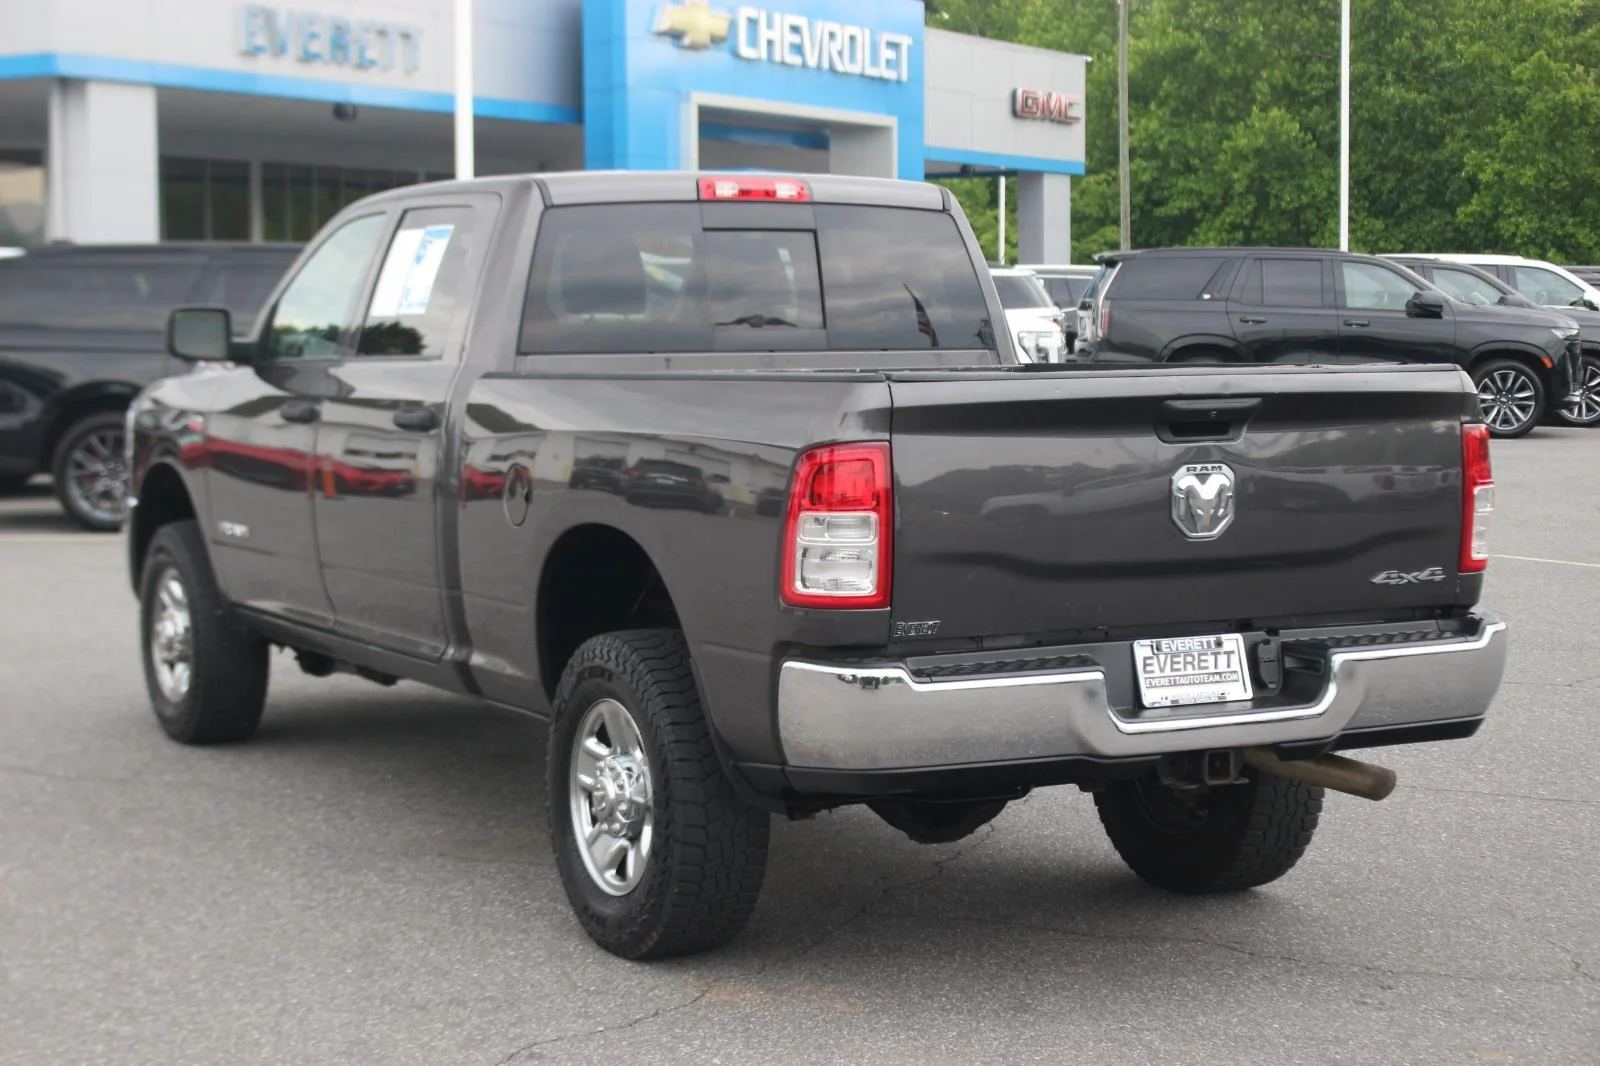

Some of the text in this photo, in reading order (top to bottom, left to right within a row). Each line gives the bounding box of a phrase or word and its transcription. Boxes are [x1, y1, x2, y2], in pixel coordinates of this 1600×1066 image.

[239, 5, 422, 74] EVERETT
[736, 6, 913, 82] CHEVROLET
[1013, 87, 1081, 125] GMC
[1186, 465, 1223, 473] RAM
[1161, 637, 1217, 652] EVERETT
[1143, 650, 1235, 674] EVERETT
[1145, 672, 1239, 688] EVERETTAUTOTEAM.COM
